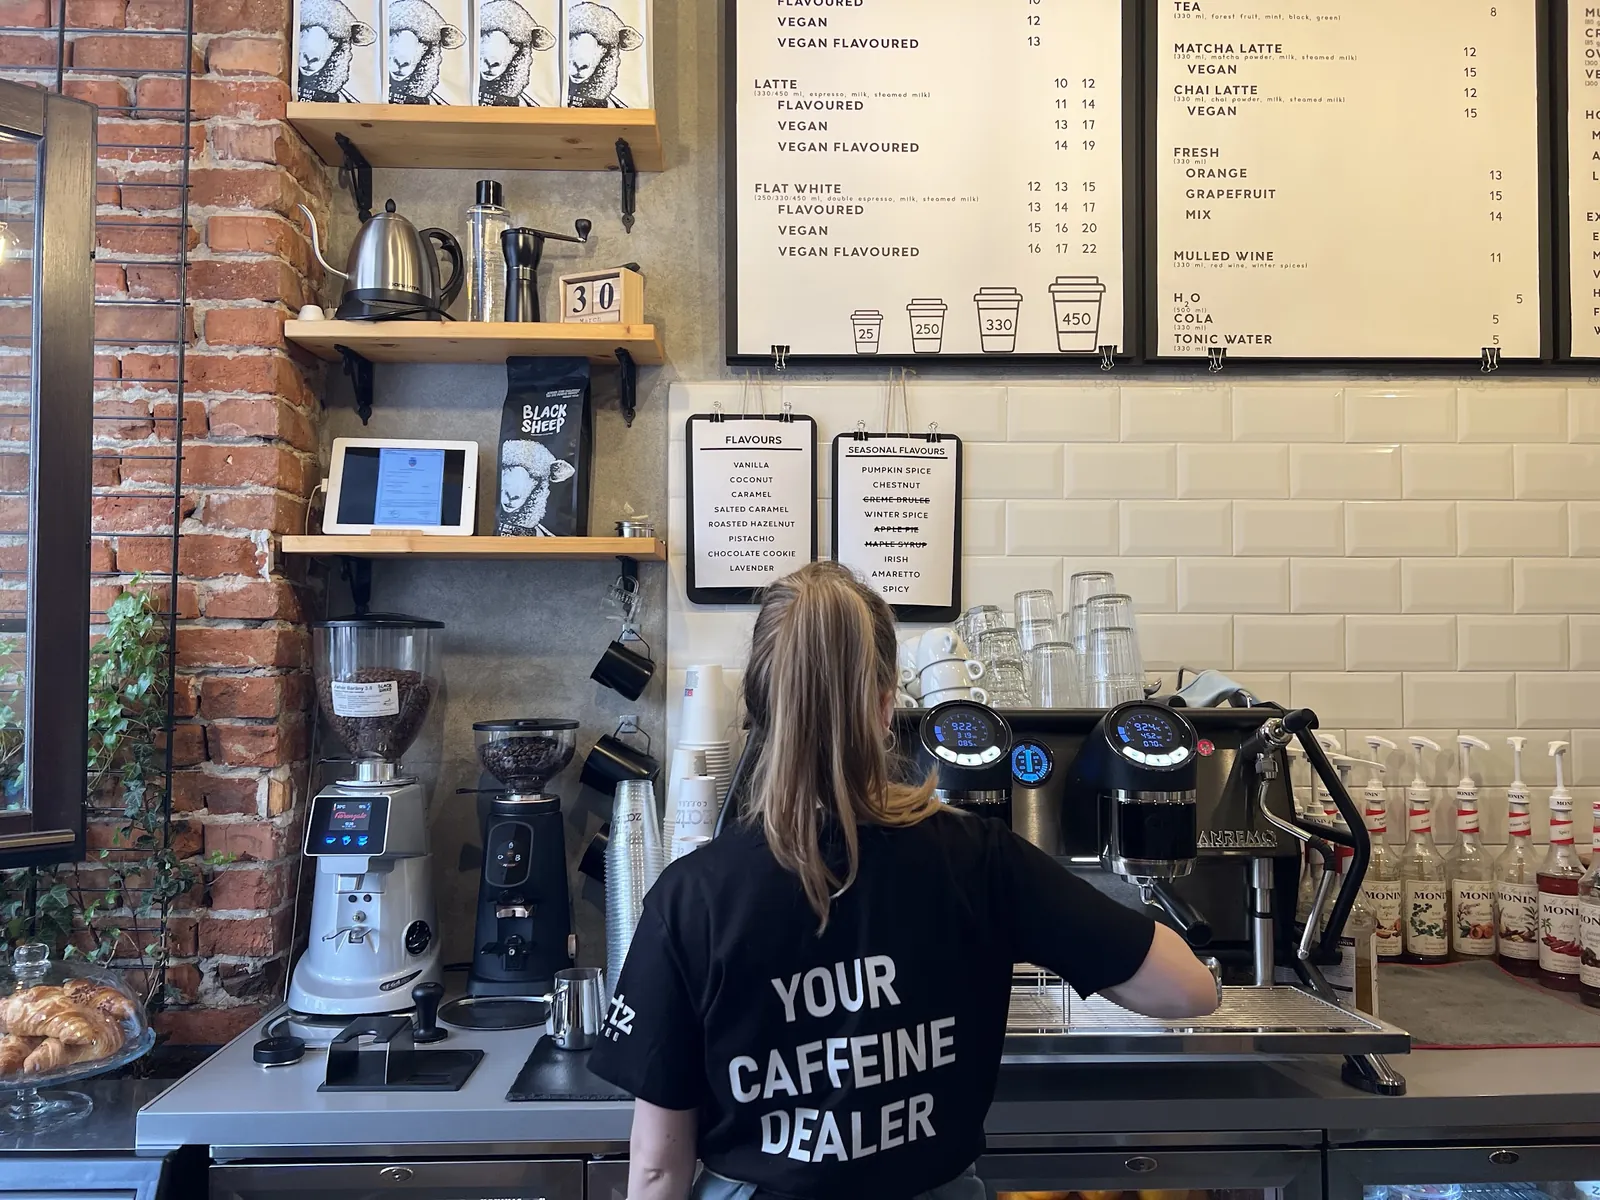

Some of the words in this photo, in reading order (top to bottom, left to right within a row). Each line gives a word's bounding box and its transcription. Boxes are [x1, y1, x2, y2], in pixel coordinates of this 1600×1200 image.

[1174, 1, 1201, 12] TEA
[1490, 6, 1497, 17] 8
[777, 17, 827, 27] VEGAN
[1027, 15, 1041, 26] 12
[777, 37, 827, 48] VEGAN
[833, 38, 919, 49] FLAVOURED
[1027, 36, 1041, 47] 13
[1174, 44, 1234, 53] MATCHA
[1240, 44, 1282, 53] LATTE
[1464, 47, 1477, 57] 12
[1187, 64, 1237, 75] VEGAN
[1464, 67, 1477, 78] 15
[755, 79, 797, 89] LATTE
[1054, 78, 1068, 89] 10
[1082, 78, 1095, 89] 12
[1174, 84, 1209, 95] CHAI
[1215, 85, 1258, 95] LATTE
[1464, 87, 1477, 98] 12
[778, 100, 864, 111] FLAVOURED
[1055, 99, 1066, 109] 11
[1082, 99, 1095, 109] 14
[1187, 106, 1237, 116] VEGAN
[1464, 108, 1478, 118] 15
[777, 121, 828, 131] VEGAN
[1055, 119, 1068, 130] 13
[1082, 119, 1095, 130] 17
[778, 142, 828, 152] VEGAN
[834, 142, 919, 153] FLAVOURED
[1055, 140, 1068, 150] 14
[1082, 140, 1096, 151] 19
[1174, 147, 1219, 158] FRESH
[1186, 168, 1247, 178] ORANGE
[1489, 170, 1502, 181] 13
[755, 183, 789, 193] FLAT
[794, 183, 841, 194] WHITE
[1027, 181, 1041, 192] 12
[1055, 181, 1068, 192] 13
[1082, 181, 1096, 192] 15
[1186, 189, 1276, 199] GRAPEFRUIT
[1489, 190, 1503, 201] 15
[778, 204, 864, 215] FLAVOURED
[1028, 202, 1041, 212] 13
[1055, 202, 1068, 212] 14
[1083, 202, 1095, 212] 17
[1186, 209, 1211, 220] MIX
[1489, 211, 1503, 222] 14
[778, 225, 828, 236] VEGAN
[1028, 222, 1041, 233] 15
[1055, 223, 1069, 233] 16
[1081, 222, 1097, 233] 20
[778, 246, 828, 257] VEGAN
[834, 247, 920, 257] FLAVOURED
[1028, 243, 1042, 254] 16
[1055, 243, 1068, 254] 17
[1082, 243, 1097, 254] 22
[1174, 251, 1230, 261] MULLED
[1236, 252, 1274, 261] WINE
[1490, 252, 1501, 263] 11
[1516, 293, 1523, 304] 5
[1062, 313, 1091, 326] 450
[1174, 314, 1213, 323] COLA
[1492, 314, 1500, 325] 5
[916, 324, 939, 334] 250
[986, 318, 1012, 331] 330
[858, 328, 874, 339] 25
[1174, 334, 1218, 344] TONIC
[1224, 335, 1272, 344] WATER
[1492, 334, 1500, 345] 5
[522, 403, 568, 421] BLACK
[521, 417, 565, 434] SHEEP
[725, 435, 782, 445] FLAVOURS
[848, 446, 897, 454] SEASONAL
[899, 447, 945, 455] FLAVOURS
[861, 466, 903, 474] PUMPKIN
[905, 467, 931, 475] SPICE
[729, 476, 773, 484] COCONUT
[872, 481, 920, 489] CHESTNUT
[748, 505, 789, 513] CARAMEL
[902, 511, 928, 519] SPICE
[708, 520, 748, 528] ROASTED
[750, 520, 795, 528] HAZELNUT
[884, 555, 909, 563] IRISH
[882, 585, 910, 593] SPICY
[1414, 891, 1446, 900] MONI
[1543, 904, 1580, 916] MONI
[771, 954, 901, 1023] YOUR
[604, 993, 636, 1036] tz
[728, 1016, 956, 1103] CAFFEINE
[761, 1092, 937, 1163] DEALER
